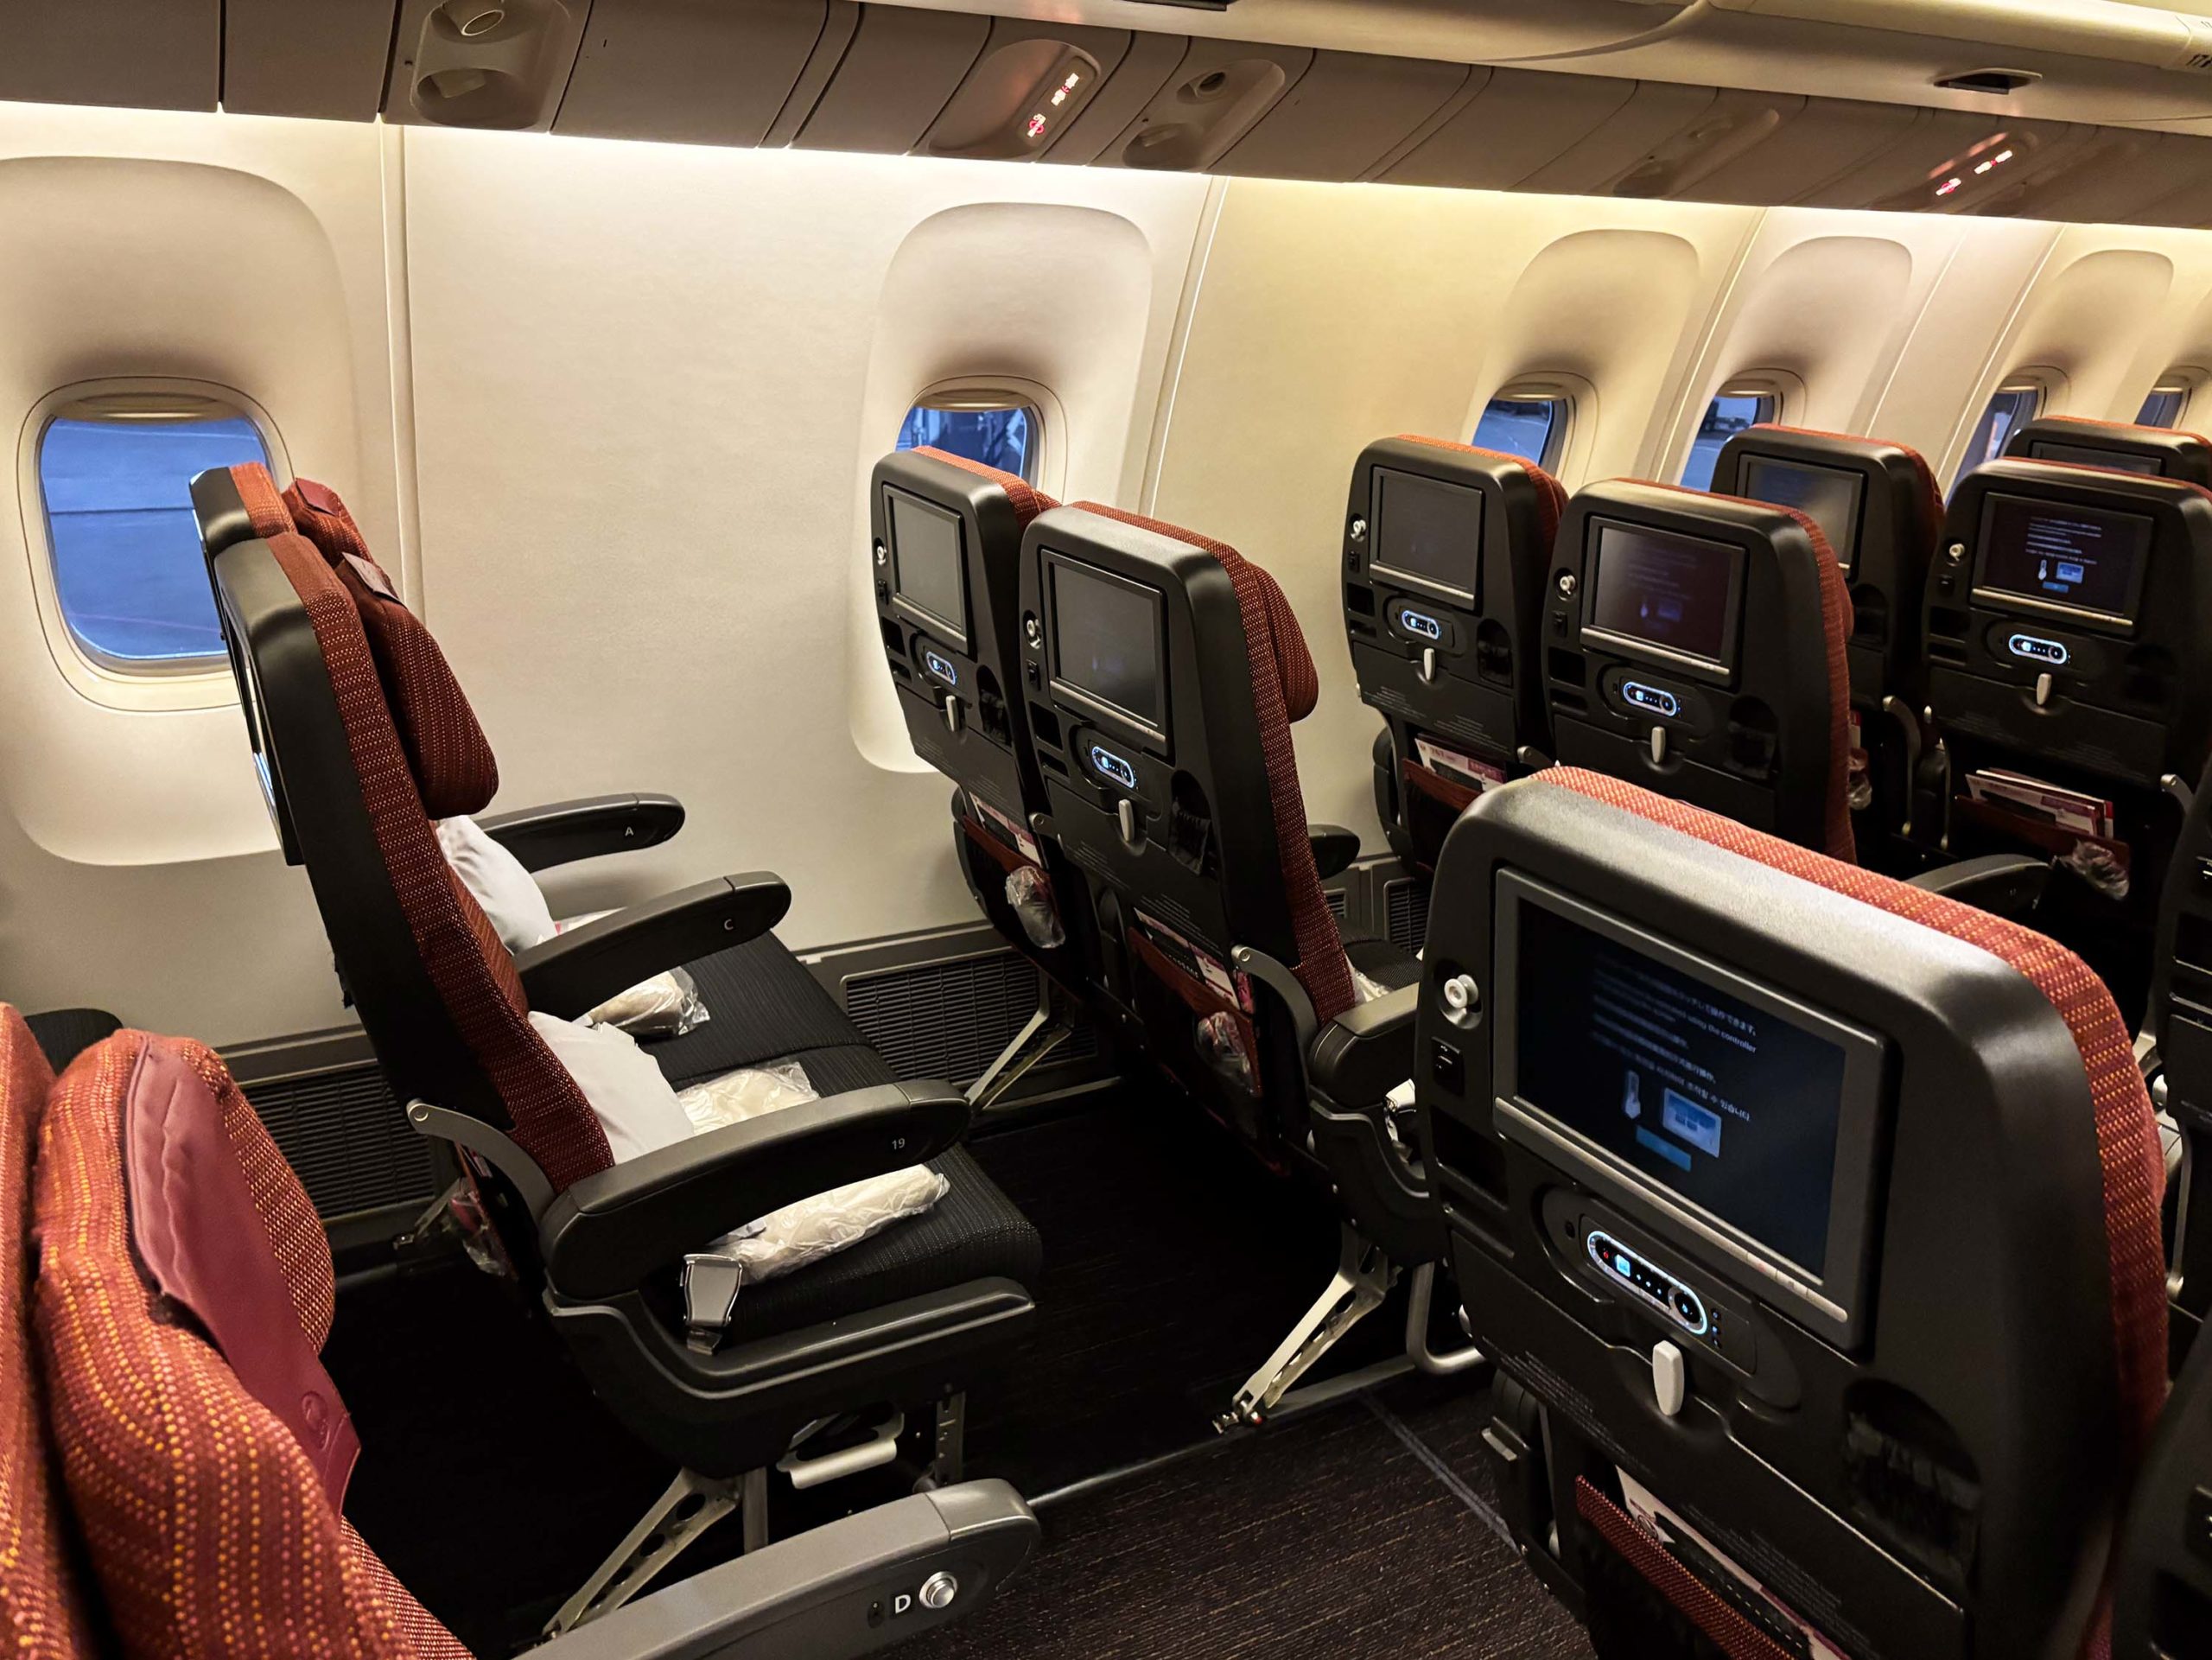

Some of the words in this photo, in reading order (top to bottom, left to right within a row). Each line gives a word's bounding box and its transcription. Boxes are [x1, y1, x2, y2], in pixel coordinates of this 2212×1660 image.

[625, 826, 634, 836] A
[724, 919, 734, 931] C
[1720, 1031, 1757, 1053] controller
[892, 1137, 906, 1149] 19
[895, 1594, 912, 1614] D
